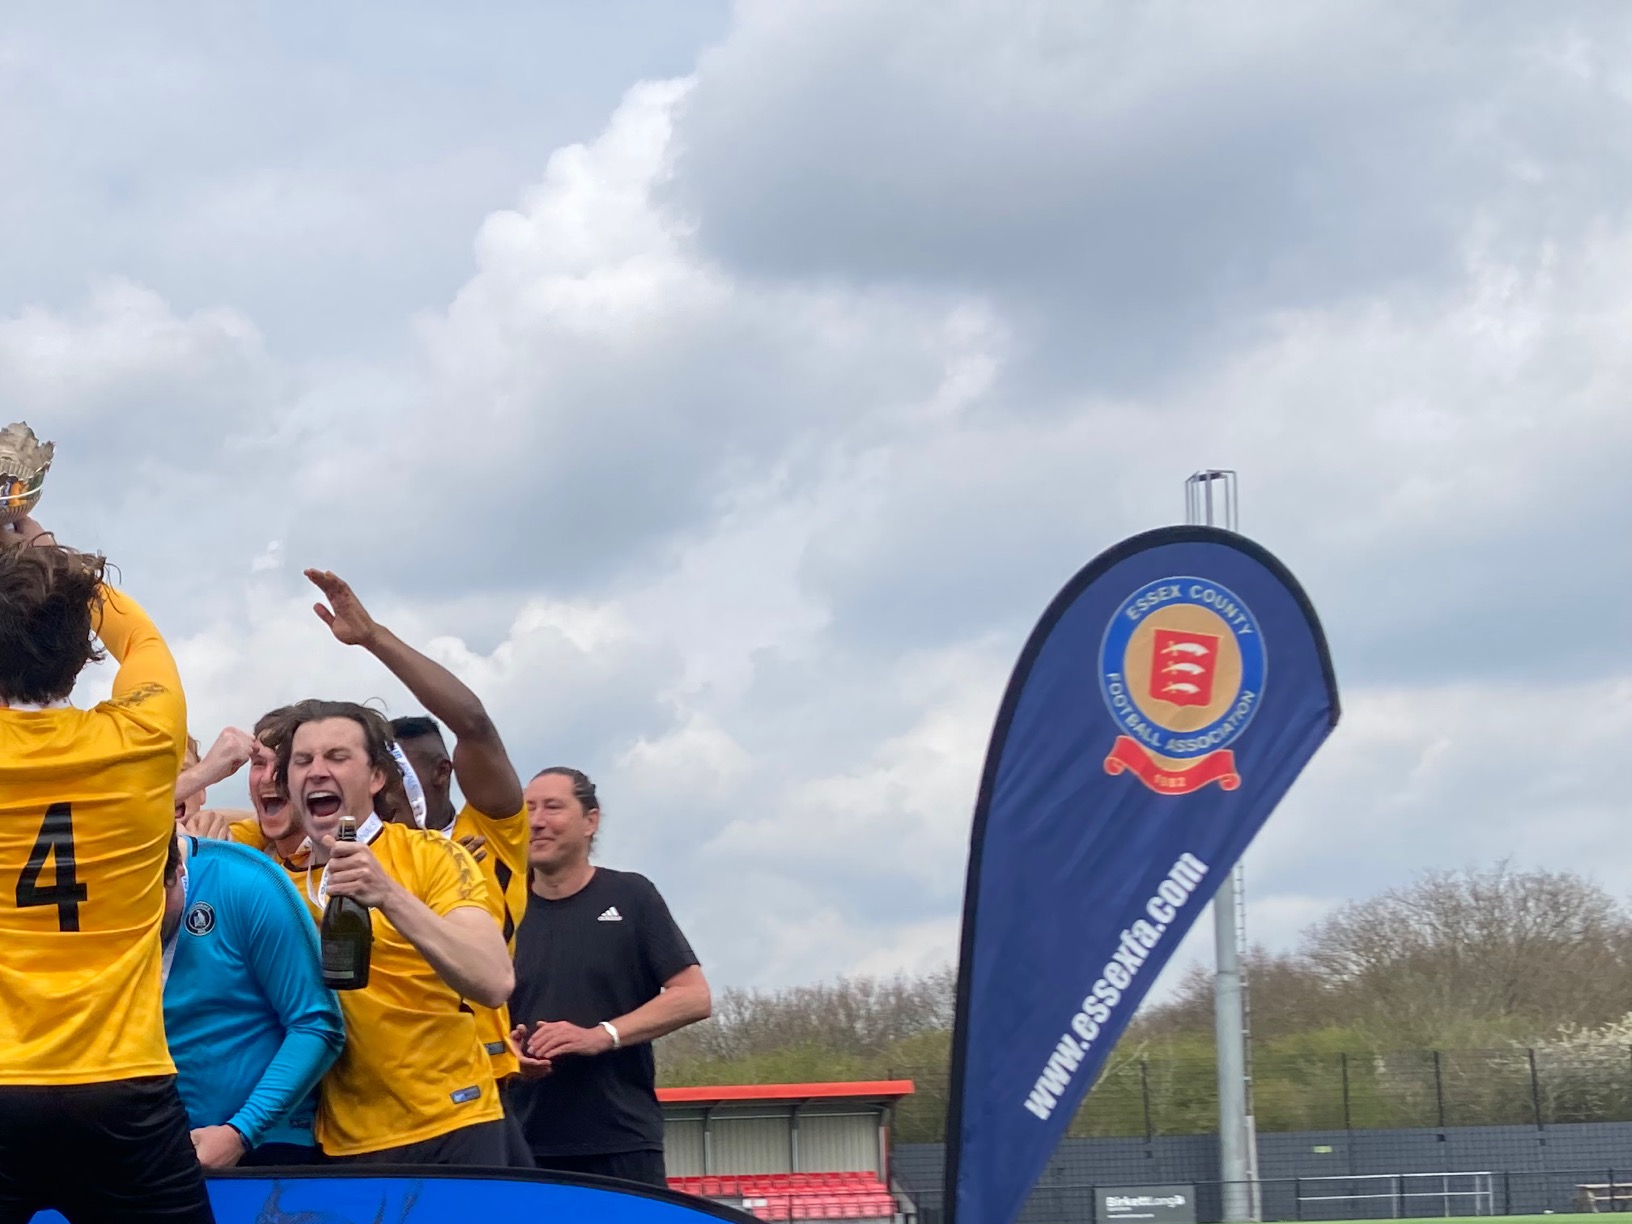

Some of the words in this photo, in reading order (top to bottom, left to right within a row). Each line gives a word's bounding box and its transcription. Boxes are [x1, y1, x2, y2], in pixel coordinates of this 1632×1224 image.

[1126, 584, 1183, 621] ESSEX
[1189, 584, 1254, 635] COUNTY
[1106, 672, 1162, 747] FOOTBALL
[1165, 690, 1256, 752] ASSOCIATION
[15, 801, 89, 933] 4
[1024, 852, 1210, 1121] www.essexfa.com
